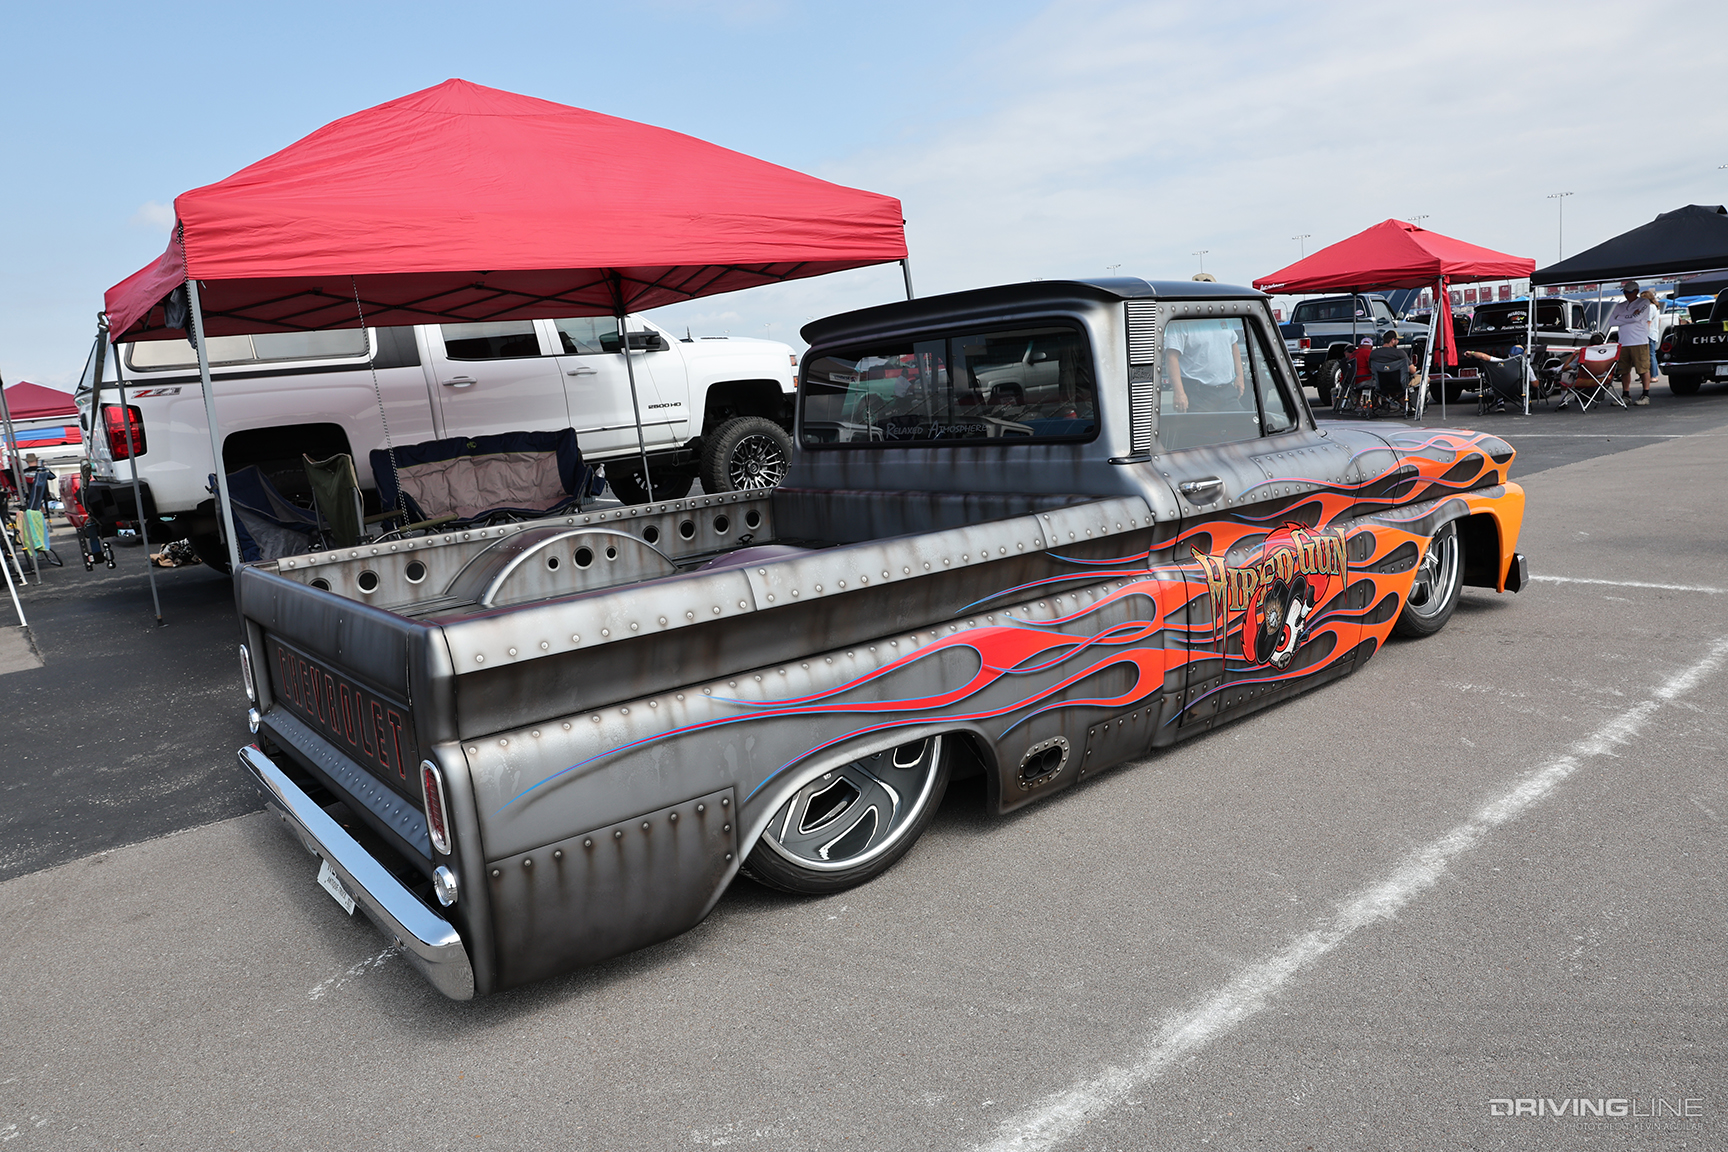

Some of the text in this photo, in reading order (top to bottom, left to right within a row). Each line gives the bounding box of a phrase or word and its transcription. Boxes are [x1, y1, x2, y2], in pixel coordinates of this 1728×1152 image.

[1692, 335, 1728, 344] CHEV
[131, 387, 182, 399] Z71
[886, 420, 988, 439] RELAXED ATMOSPHERE
[1190, 526, 1349, 670] HIRED GUN
[278, 648, 406, 779] CHEVROLET
